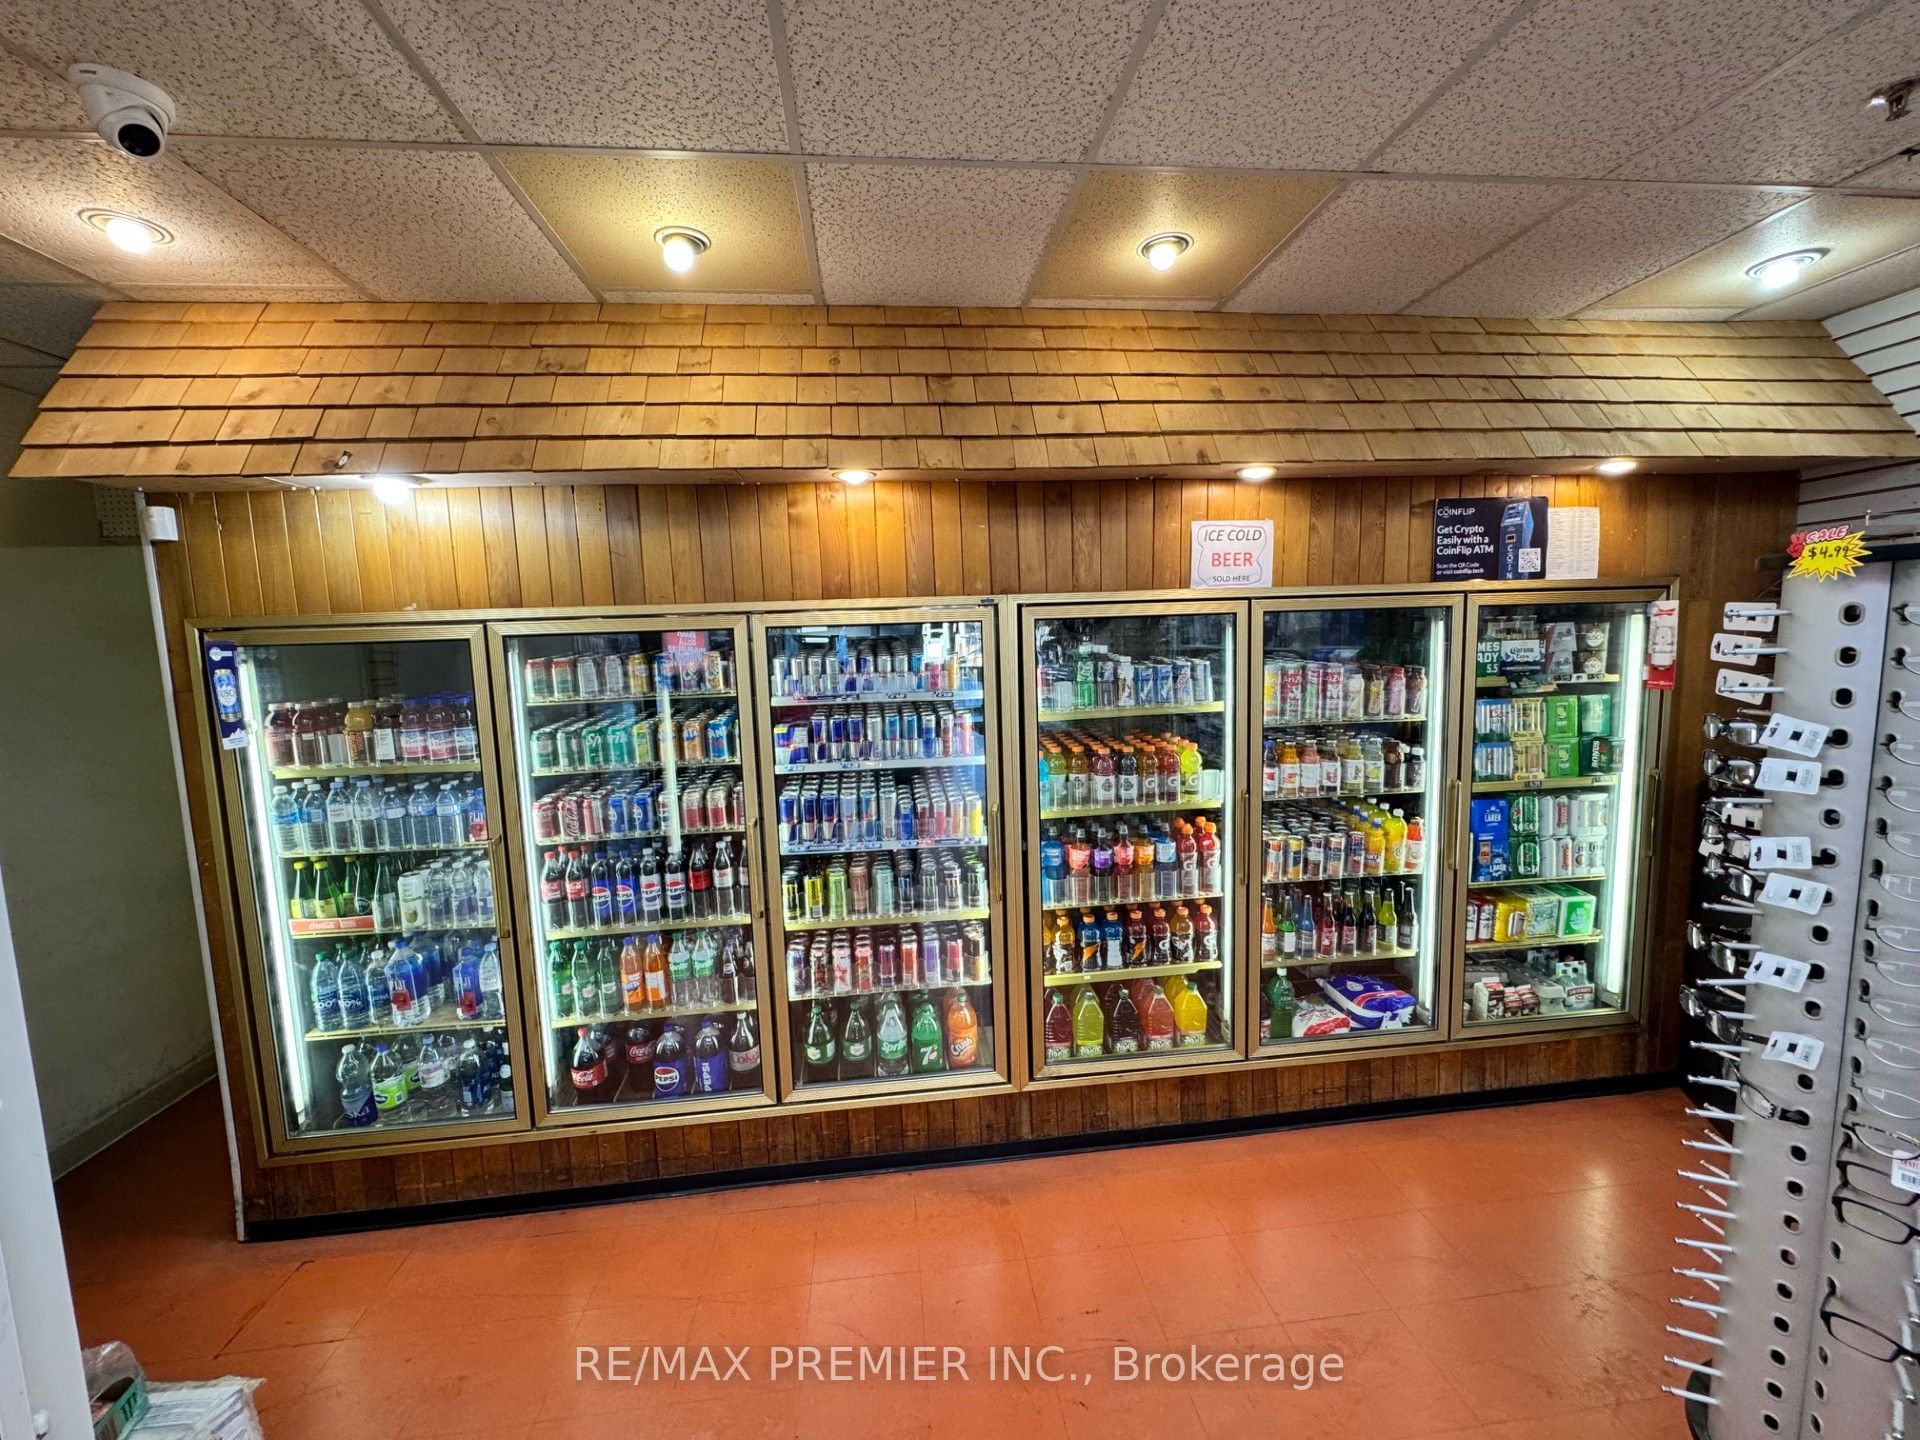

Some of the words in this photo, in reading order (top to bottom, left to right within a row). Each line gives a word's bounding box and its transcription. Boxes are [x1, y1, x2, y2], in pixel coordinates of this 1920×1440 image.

[1437, 507, 1476, 517] COINFLIP
[1204, 529, 1225, 542] ICE
[1227, 529, 1262, 541] COLD
[1437, 525, 1453, 534] Get
[1454, 525, 1485, 535] Crypto
[1806, 525, 1850, 544] SALE
[1437, 536, 1462, 545] Easily
[1463, 535, 1483, 544] with
[1483, 536, 1490, 544] a
[1437, 545, 1472, 556] CoinFlip
[1473, 545, 1494, 554] ATM
[1808, 545, 1850, 560] $4.99
[1211, 552, 1253, 567] BEER
[1232, 574, 1250, 582] HERE
[1591, 740, 1600, 768] BONUS
[655, 1074, 678, 1082] PEPSI
[702, 1062, 712, 1092] PEPSI
